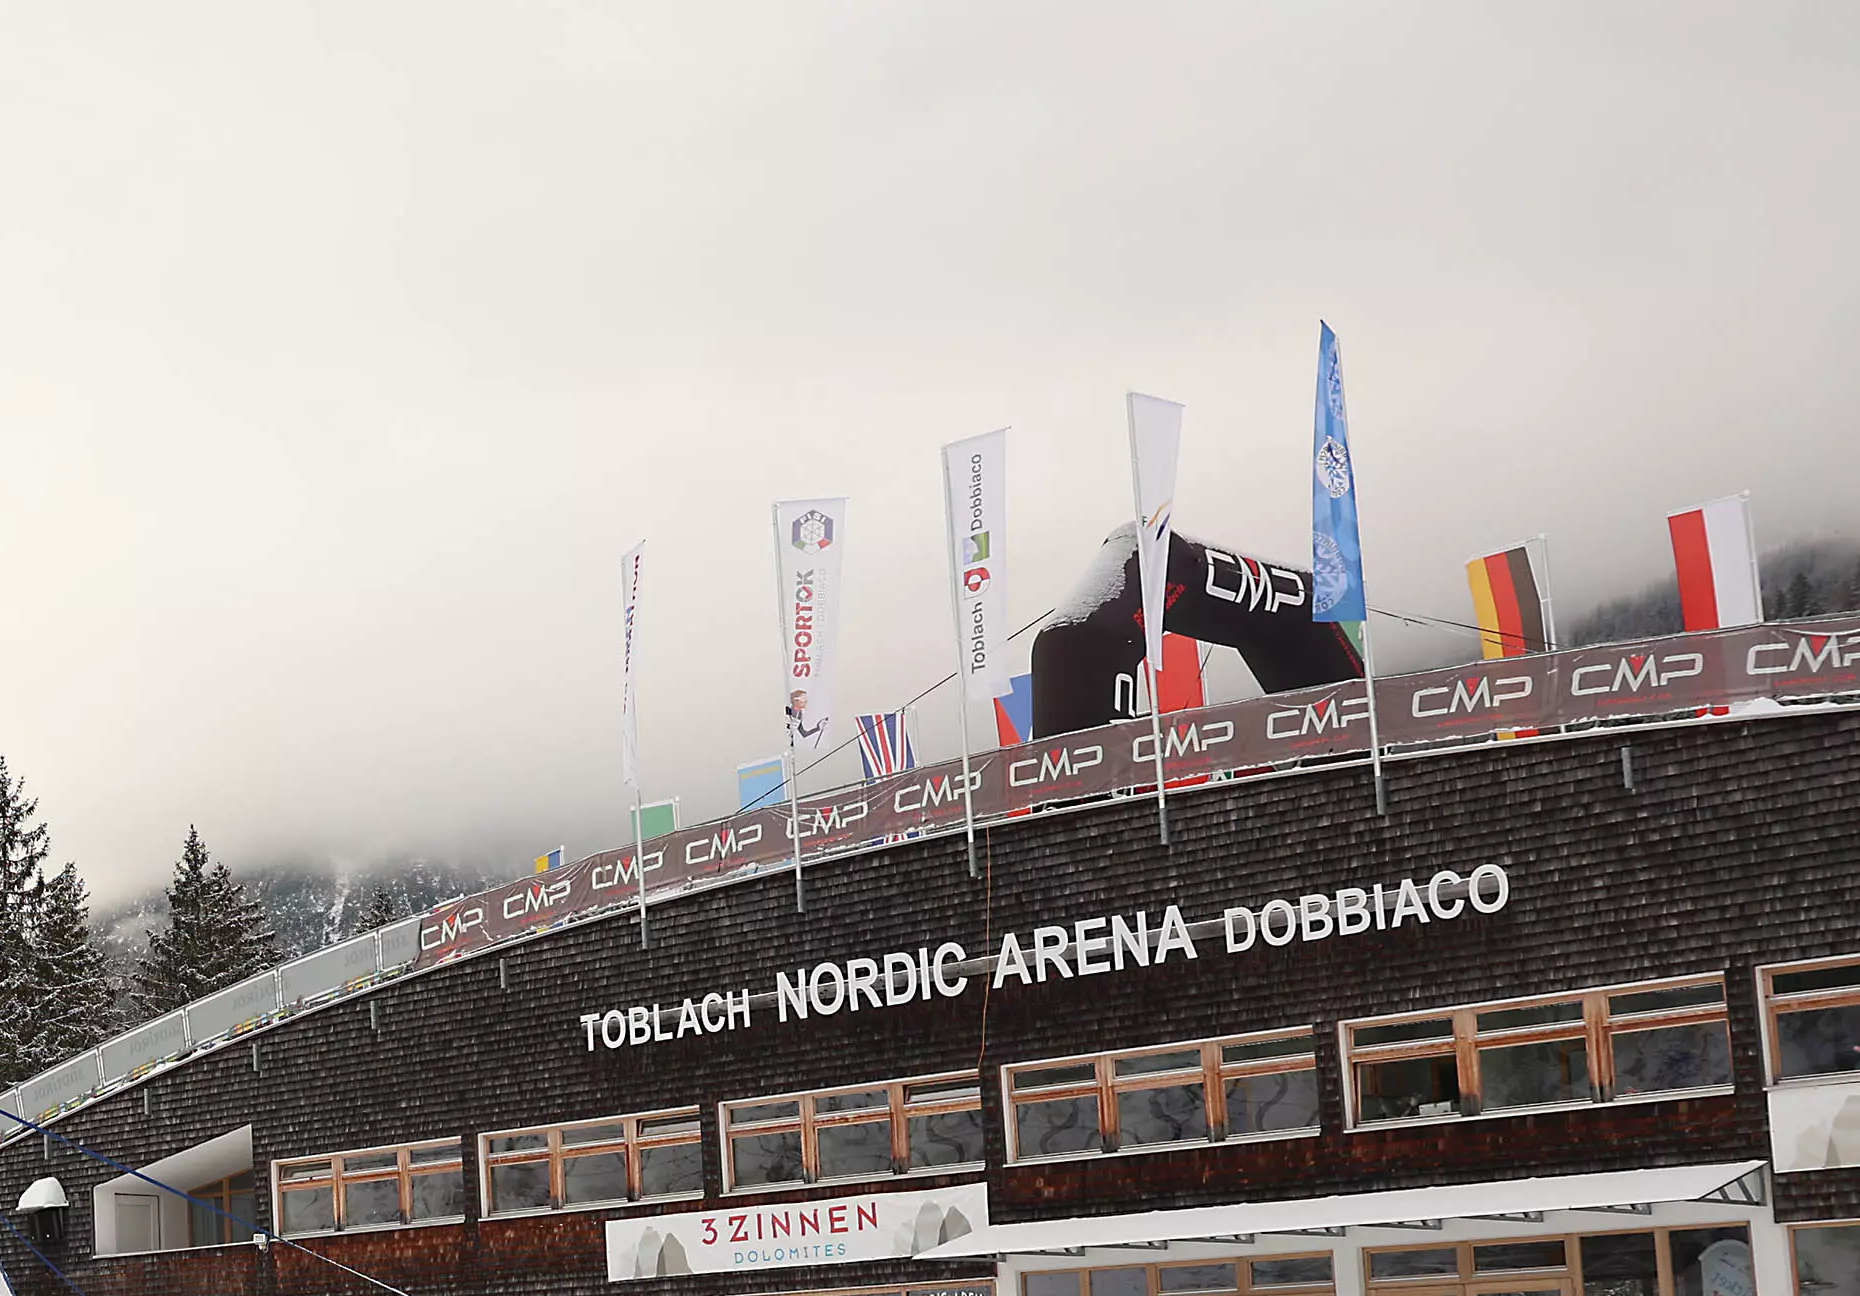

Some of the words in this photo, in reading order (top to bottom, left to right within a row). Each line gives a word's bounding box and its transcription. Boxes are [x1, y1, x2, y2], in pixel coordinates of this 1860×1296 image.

[970, 453, 983, 531] Dobbiaco
[1204, 547, 1306, 613] CMP
[970, 601, 984, 675] Toblach
[1571, 651, 1704, 697] CMP
[1266, 697, 1369, 739] CMP
[1411, 675, 1533, 718] CMP
[1132, 720, 1235, 763] CMP
[1008, 744, 1103, 787] CMP
[894, 771, 982, 813] CMP
[785, 801, 868, 839] CMP
[685, 824, 762, 865] CMP
[591, 849, 664, 890] CMP
[502, 879, 572, 920] CMP
[420, 907, 483, 951] CMP
[580, 985, 752, 1053] TOBLACH
[776, 941, 969, 1024] NORDIC
[992, 905, 1198, 990] ARENA
[1223, 863, 1511, 954] DOBBIACO
[700, 1217, 719, 1246] 3
[728, 1201, 880, 1243] ZINNEN
[733, 1243, 847, 1264] DOLOMITES
